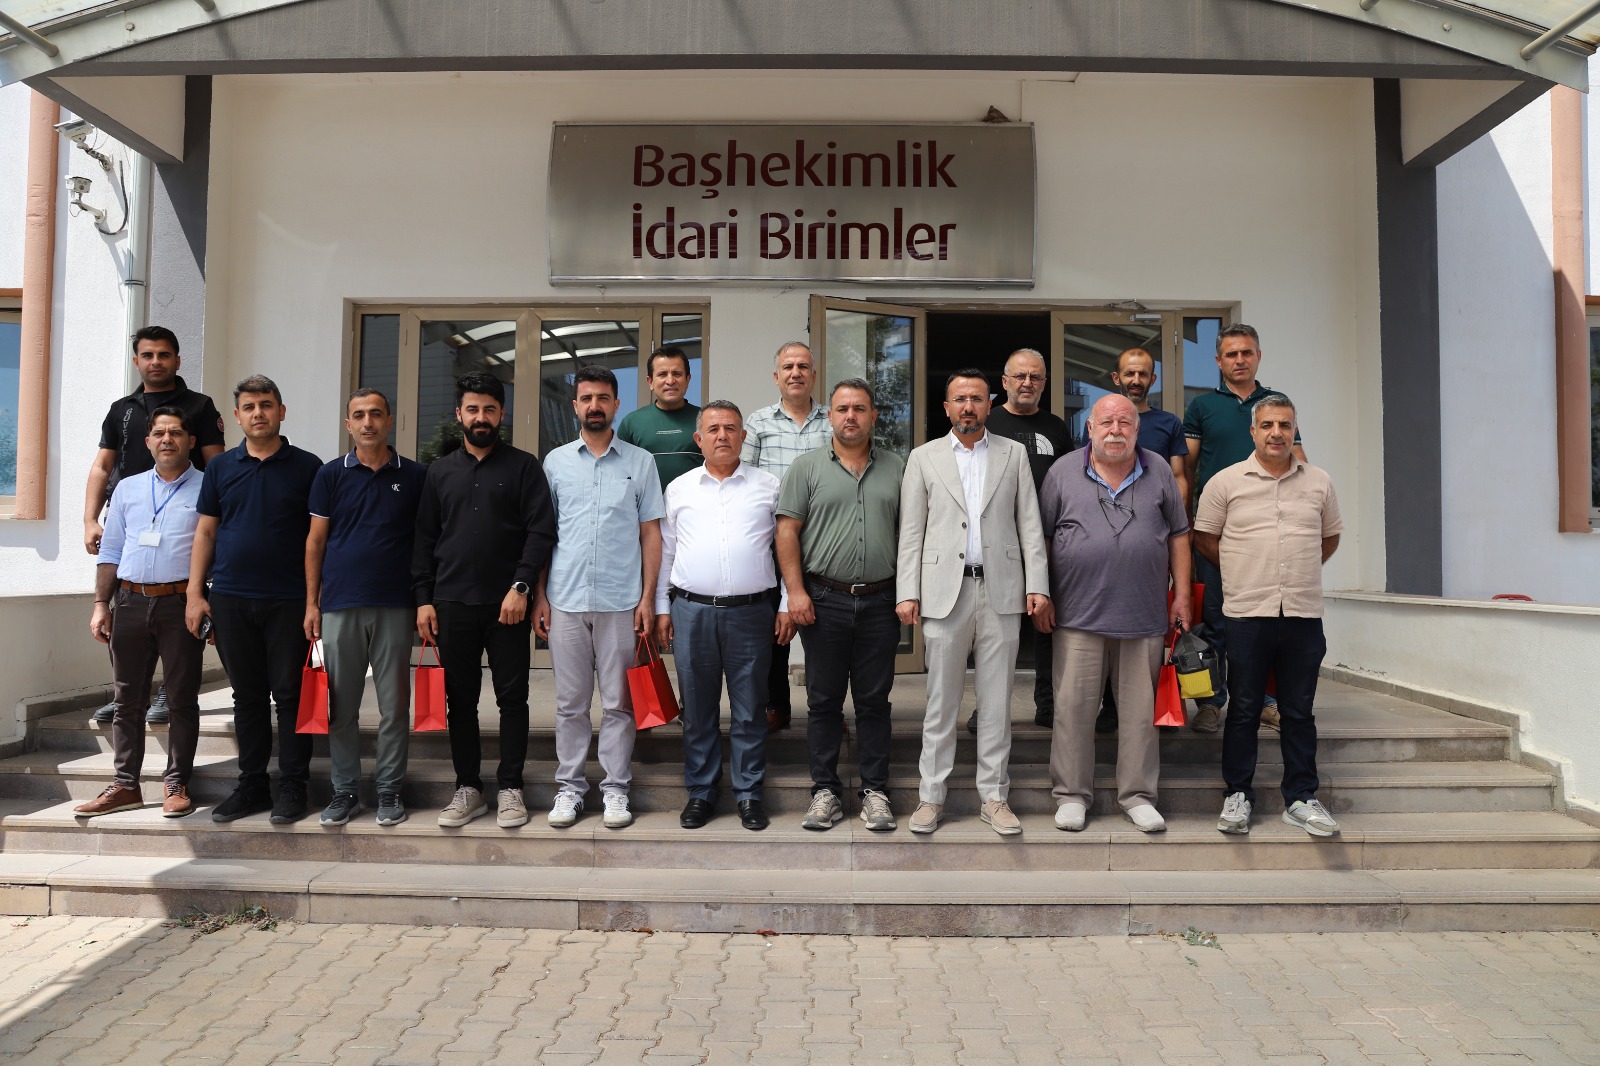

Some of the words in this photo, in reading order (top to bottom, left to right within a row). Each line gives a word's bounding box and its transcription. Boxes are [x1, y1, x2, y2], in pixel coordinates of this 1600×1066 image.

[633, 139, 958, 199] Başhekimlik
[632, 202, 738, 260] İdari
[759, 207, 957, 261] Birimler
